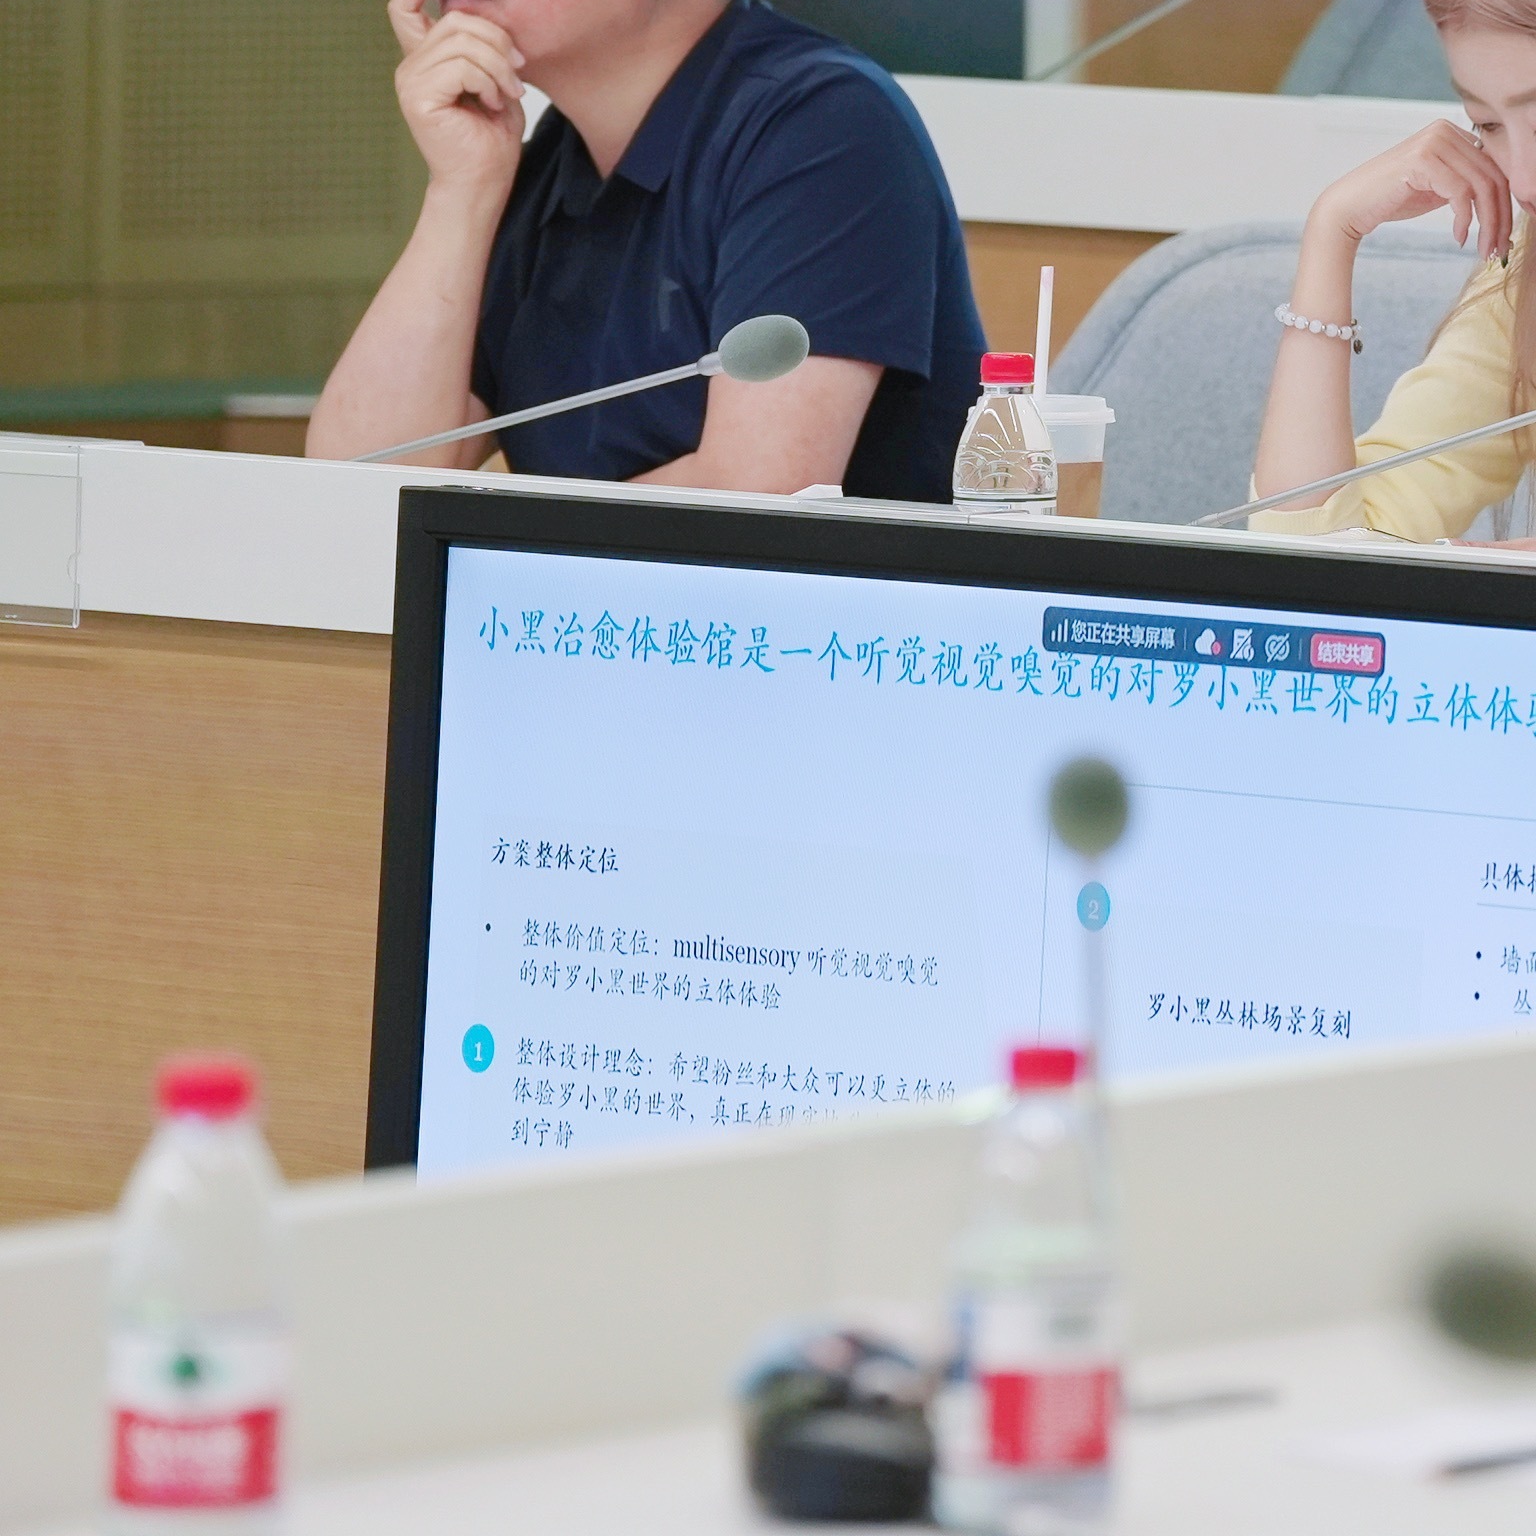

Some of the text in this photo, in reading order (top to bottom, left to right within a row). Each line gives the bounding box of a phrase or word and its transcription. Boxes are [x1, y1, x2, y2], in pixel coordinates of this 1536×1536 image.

[1071, 618, 1175, 651] 您正在共享屏幕
[1317, 641, 1375, 668] 结束共享
[491, 836, 620, 874] 方案整体定位
[1087, 900, 1100, 920] 2
[672, 934, 801, 976] multisensory
[806, 946, 939, 987] 听觉视觉嗅觉
[518, 958, 783, 1010] 的对罗小黑世界的立体体验
[1147, 992, 1351, 1040] 罗小黑丛林场景复刻
[510, 1117, 575, 1150] 到宁静
